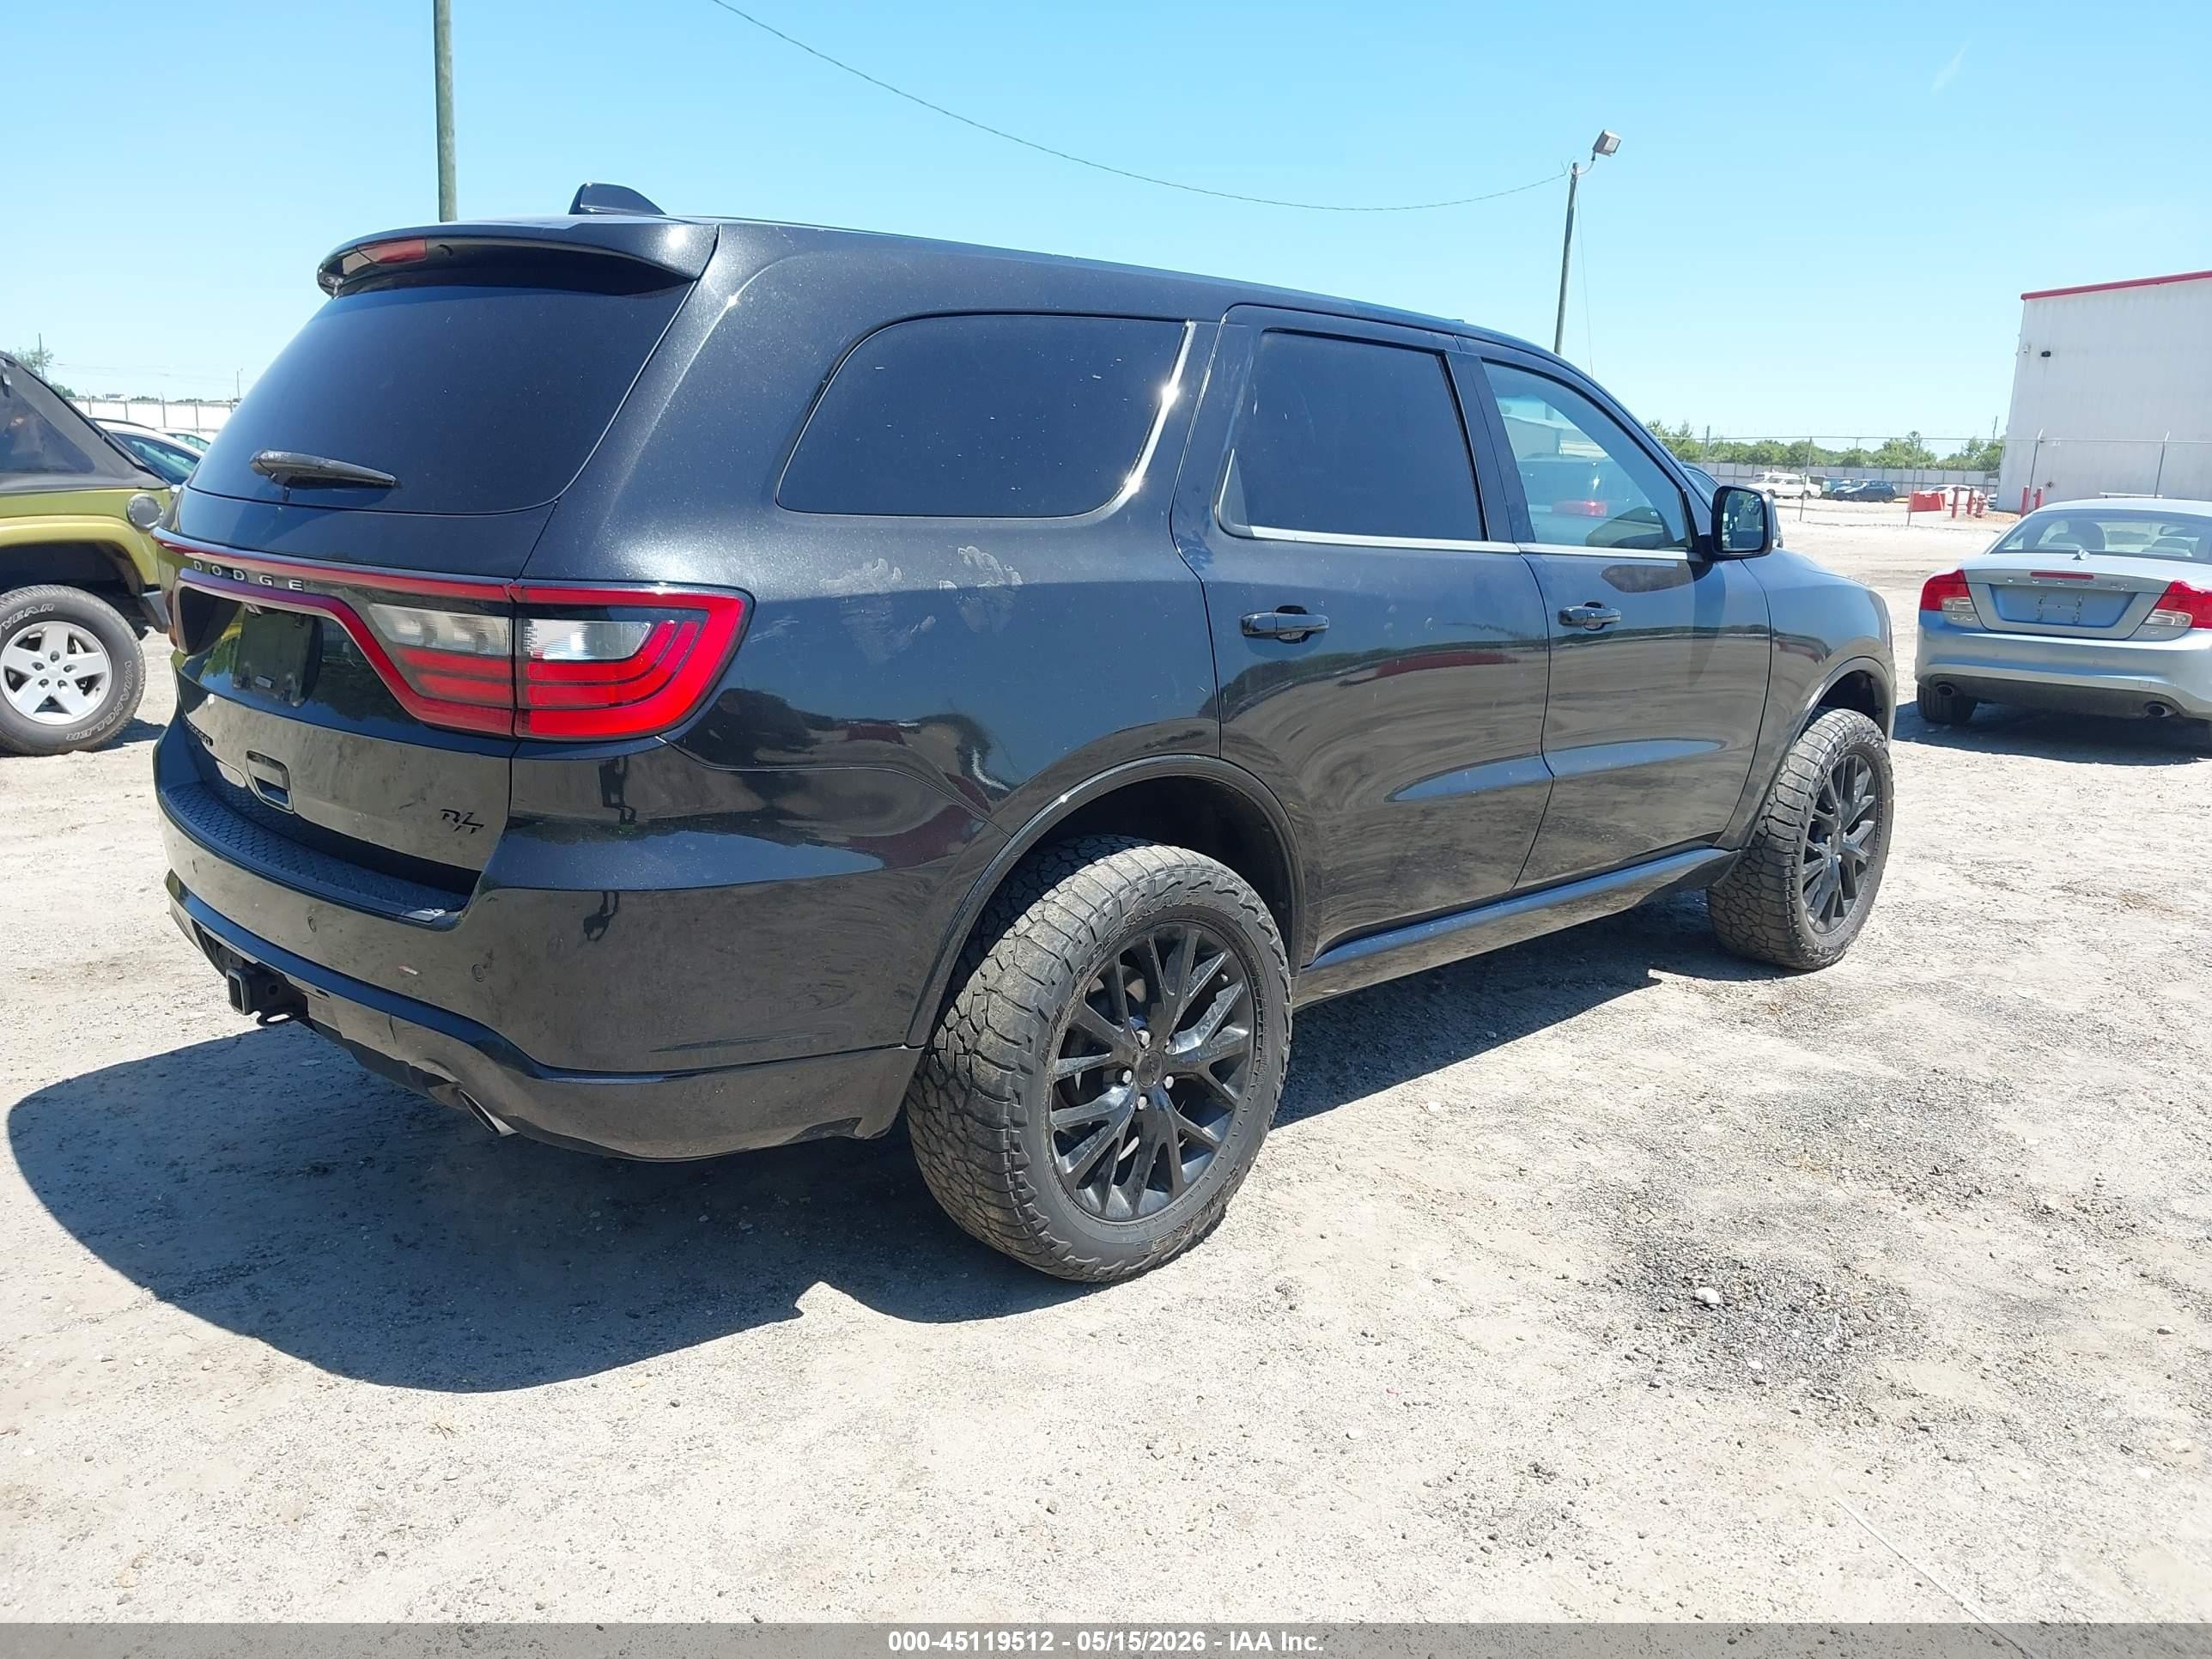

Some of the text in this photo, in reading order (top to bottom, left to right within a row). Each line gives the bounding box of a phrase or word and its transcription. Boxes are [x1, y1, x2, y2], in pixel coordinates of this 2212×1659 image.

[193, 560, 303, 591] DODGE
[0, 603, 56, 631] YEAR
[66, 659, 133, 741] WRANGLER
